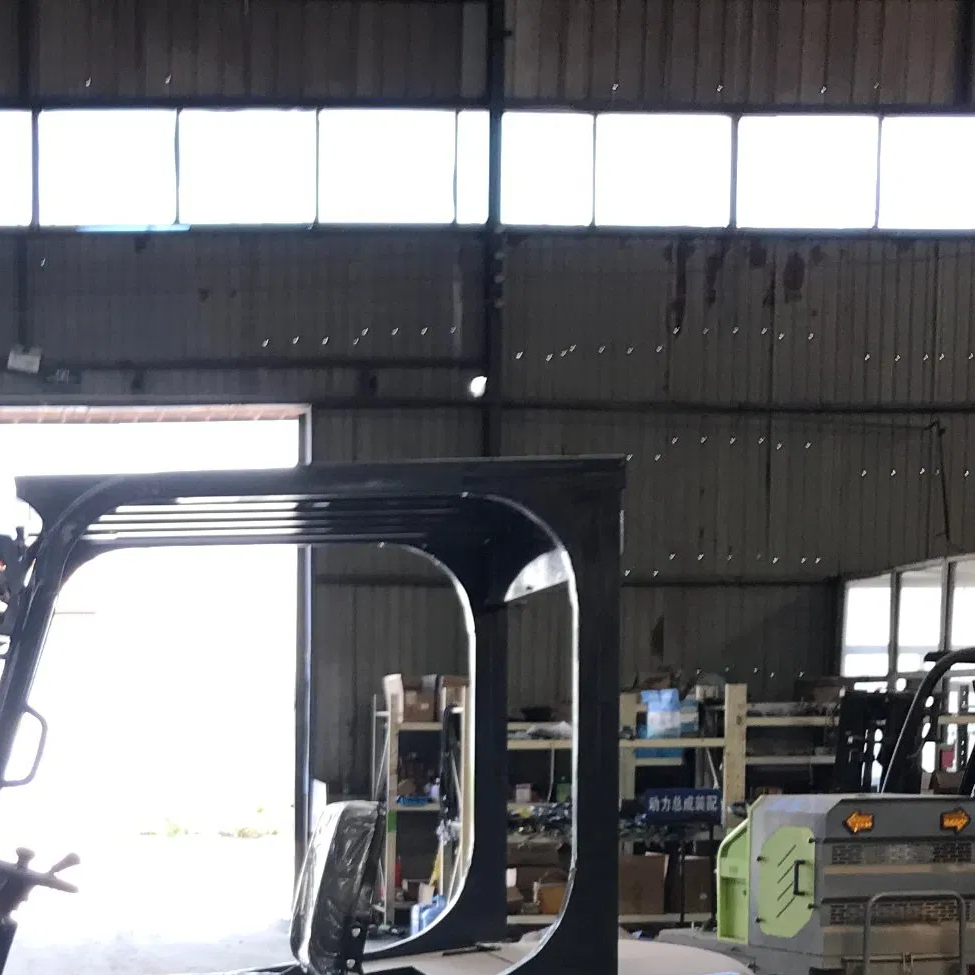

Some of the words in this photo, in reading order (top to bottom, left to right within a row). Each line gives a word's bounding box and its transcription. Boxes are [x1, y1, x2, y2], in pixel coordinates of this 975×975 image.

[648, 794, 719, 813] 动力总成装配
